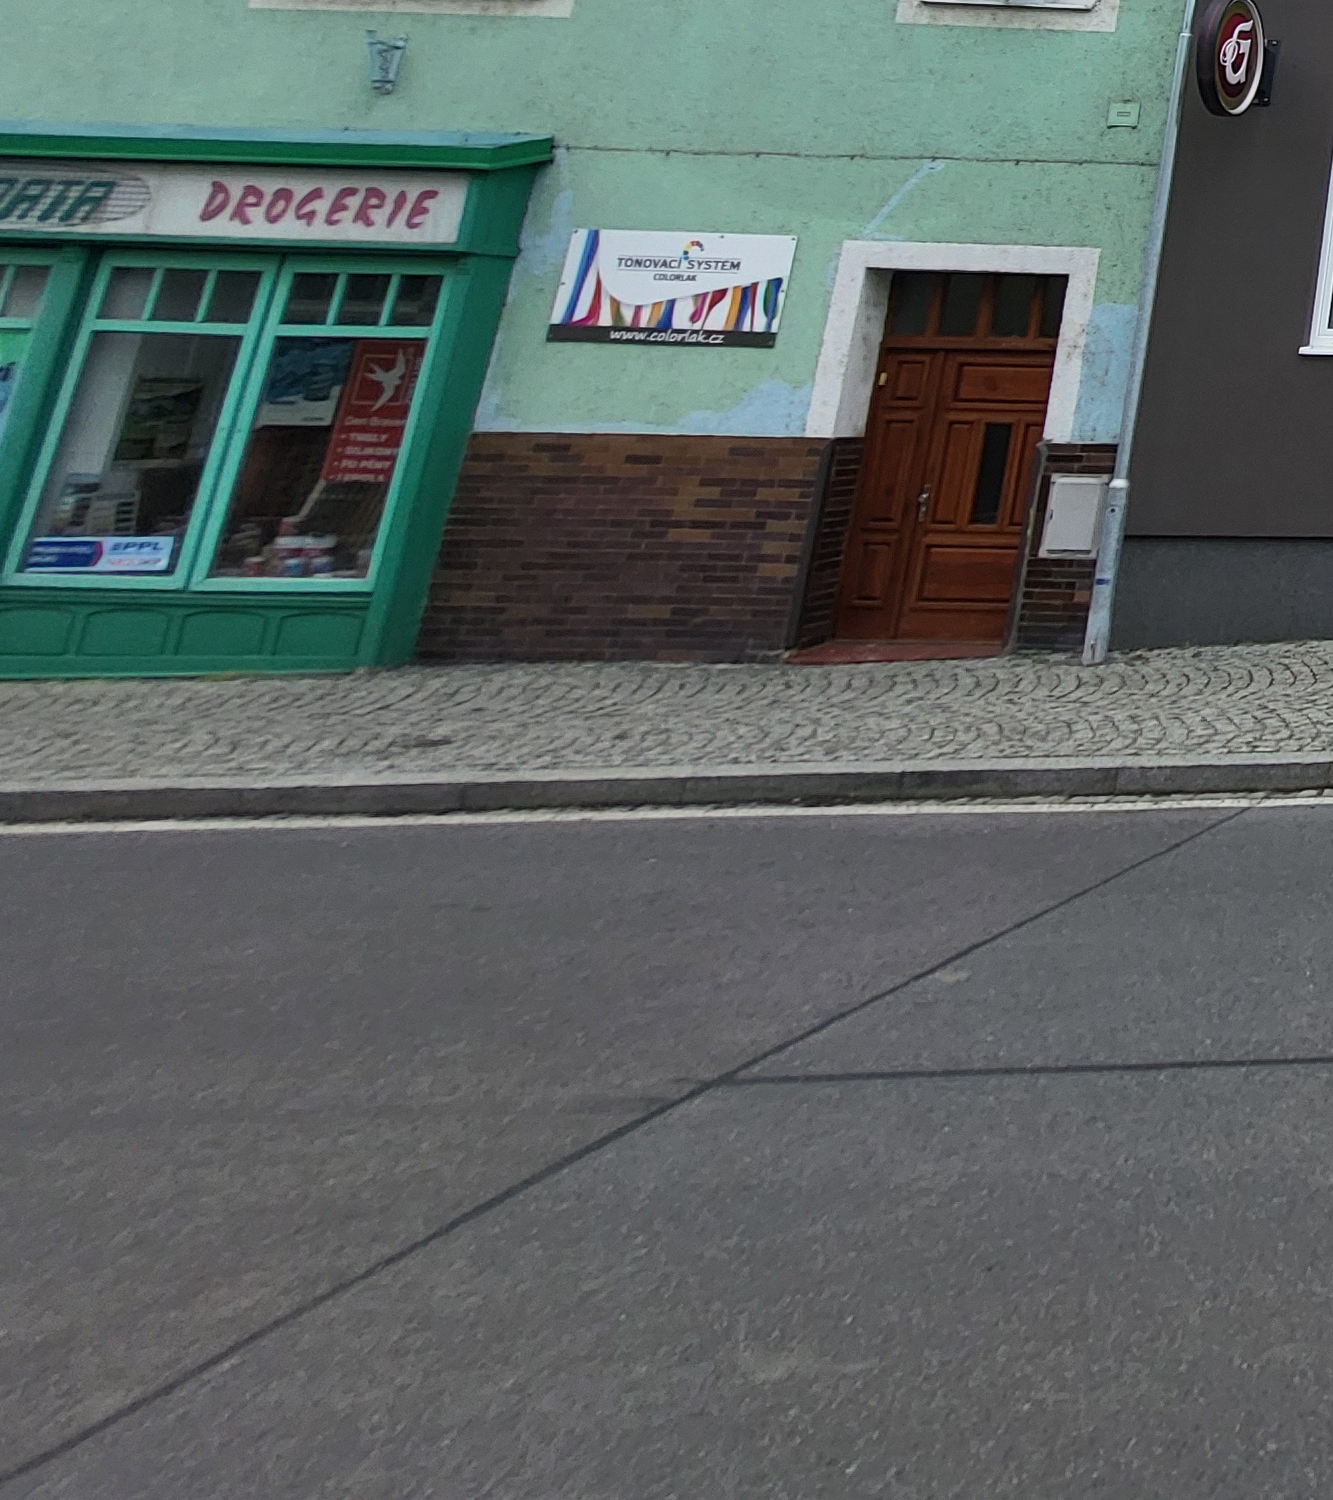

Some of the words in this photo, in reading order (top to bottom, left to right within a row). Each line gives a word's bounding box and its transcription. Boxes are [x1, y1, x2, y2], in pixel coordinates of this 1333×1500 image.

[199, 180, 439, 229] DROGERIE
[616, 256, 682, 270] TONOVACÍ
[653, 273, 697, 283] COLORLAK
[609, 329, 725, 344] www.colorlak.cz
